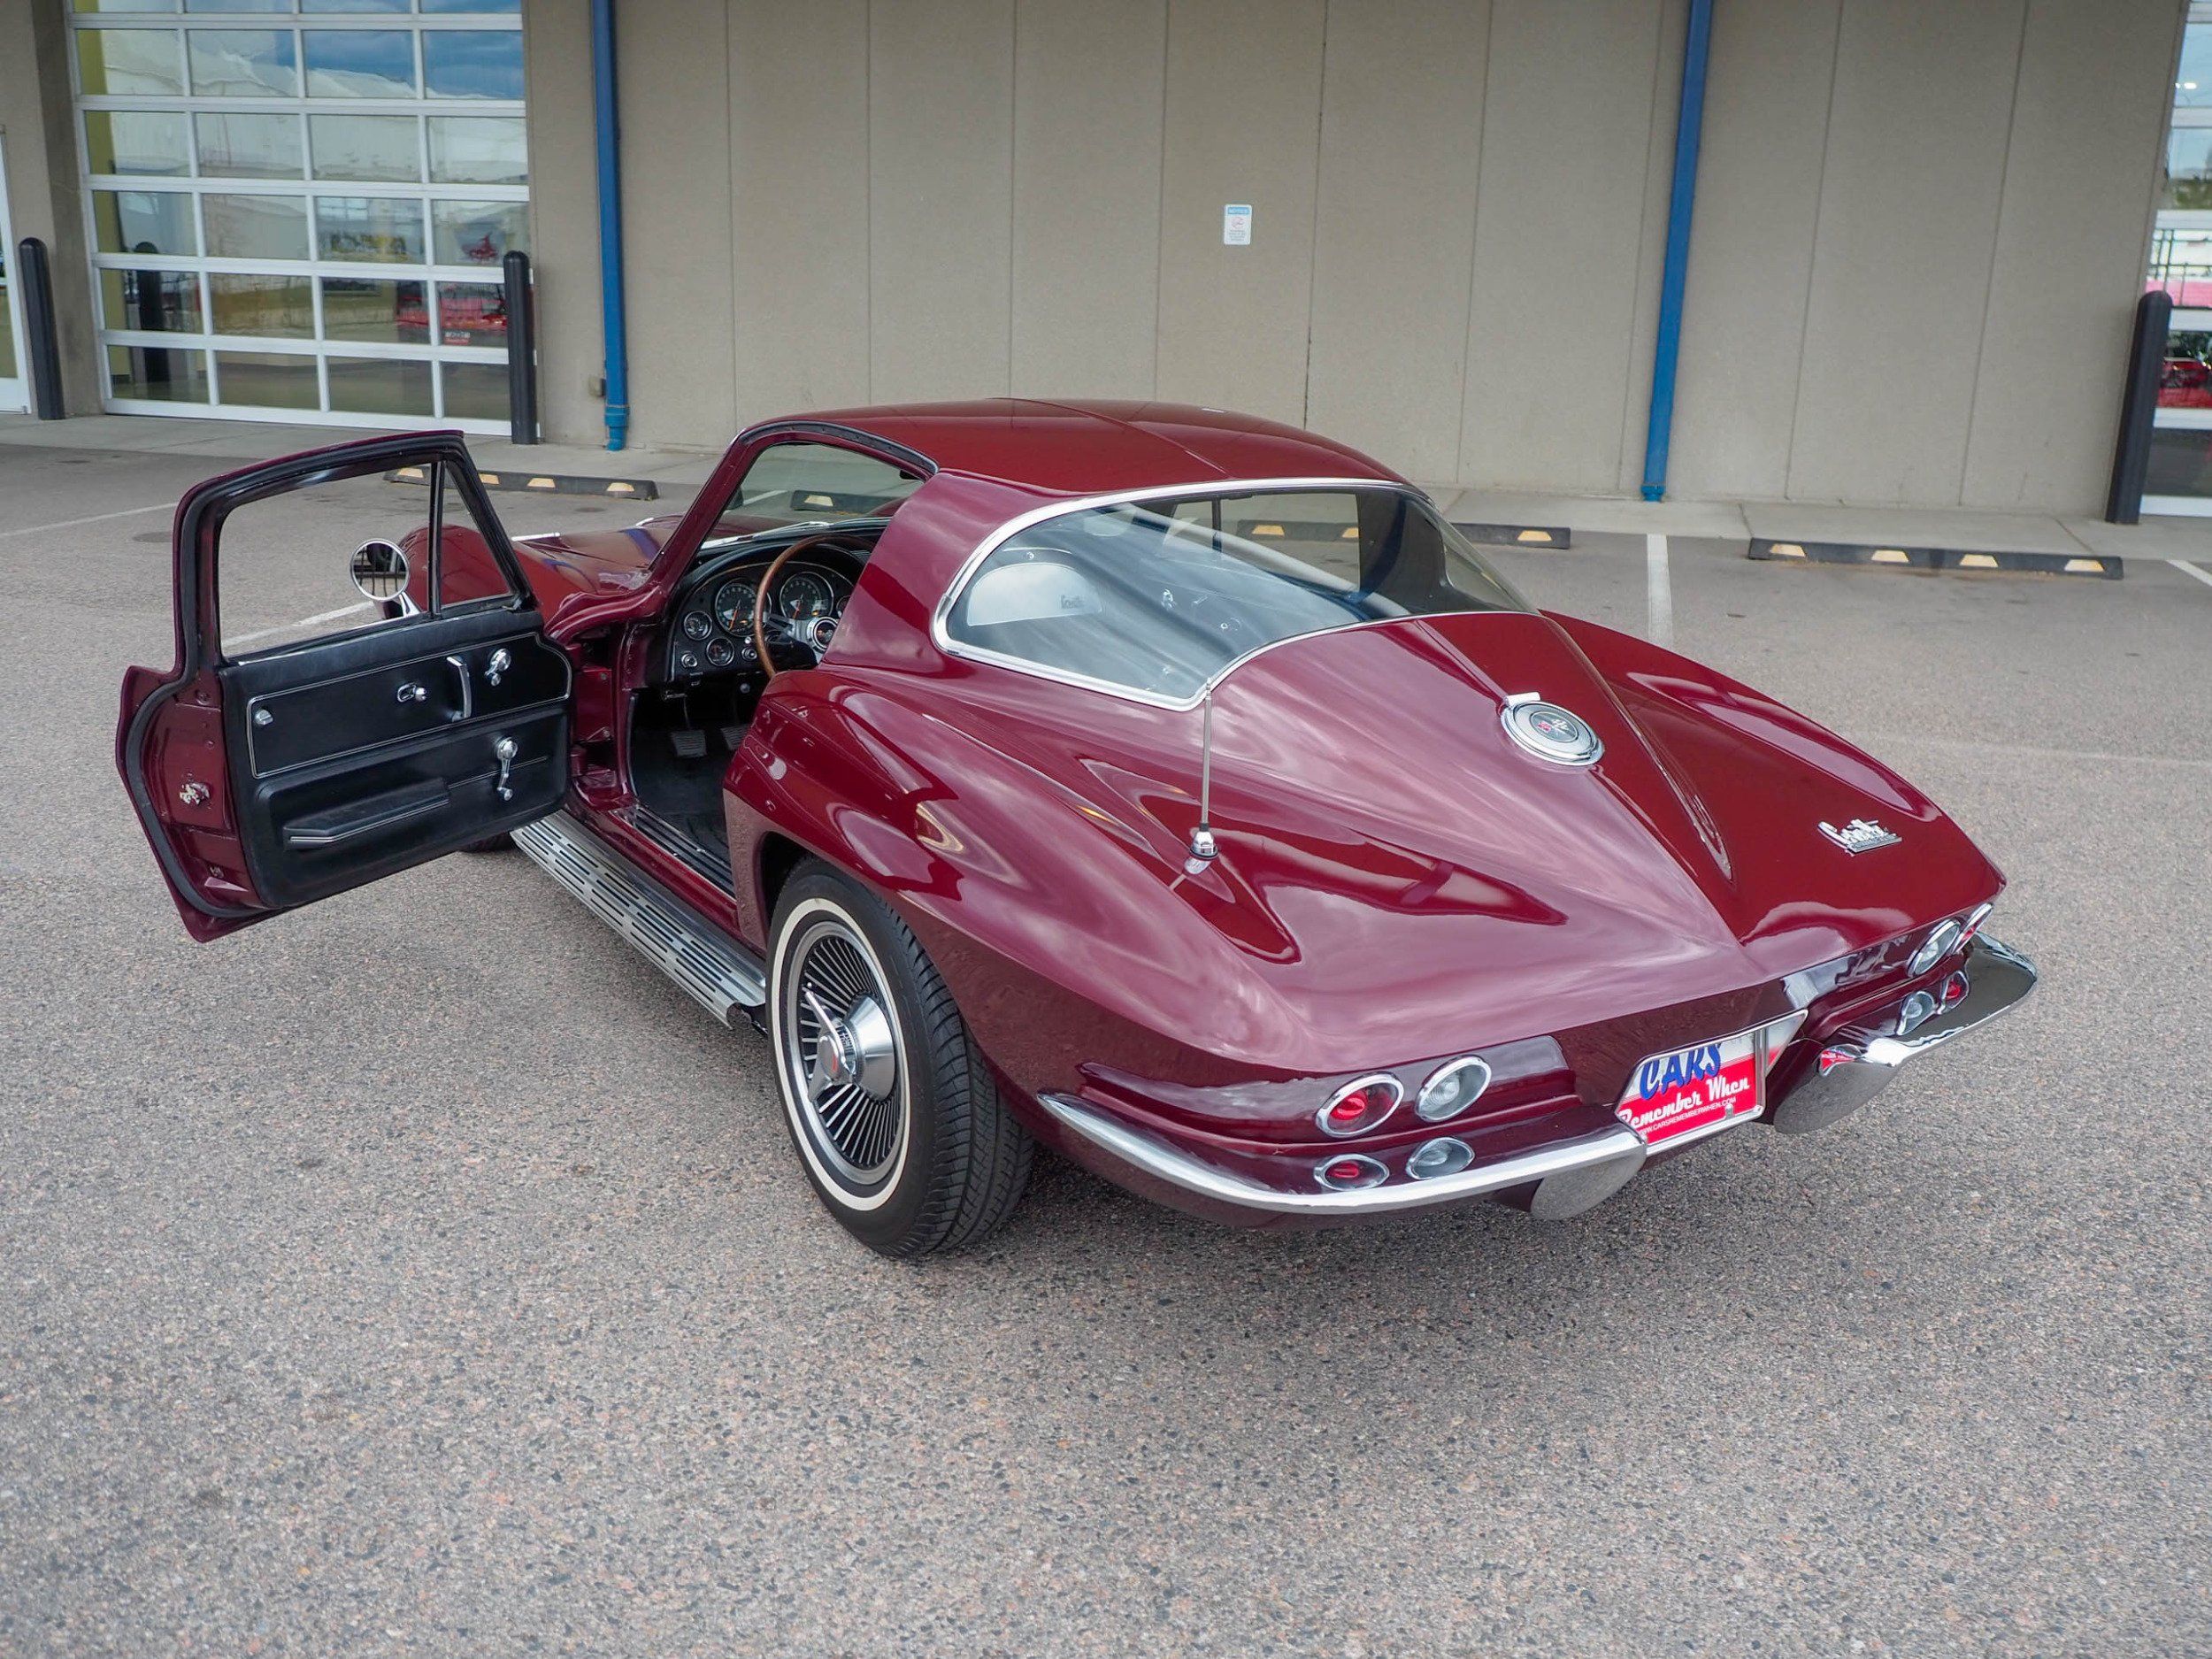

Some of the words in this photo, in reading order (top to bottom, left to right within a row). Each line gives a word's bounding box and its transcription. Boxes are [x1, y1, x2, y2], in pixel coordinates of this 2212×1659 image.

[1640, 1044, 1722, 1100] CARS
[1618, 1093, 1702, 1128] Remember
[1706, 1075, 1750, 1101] When
